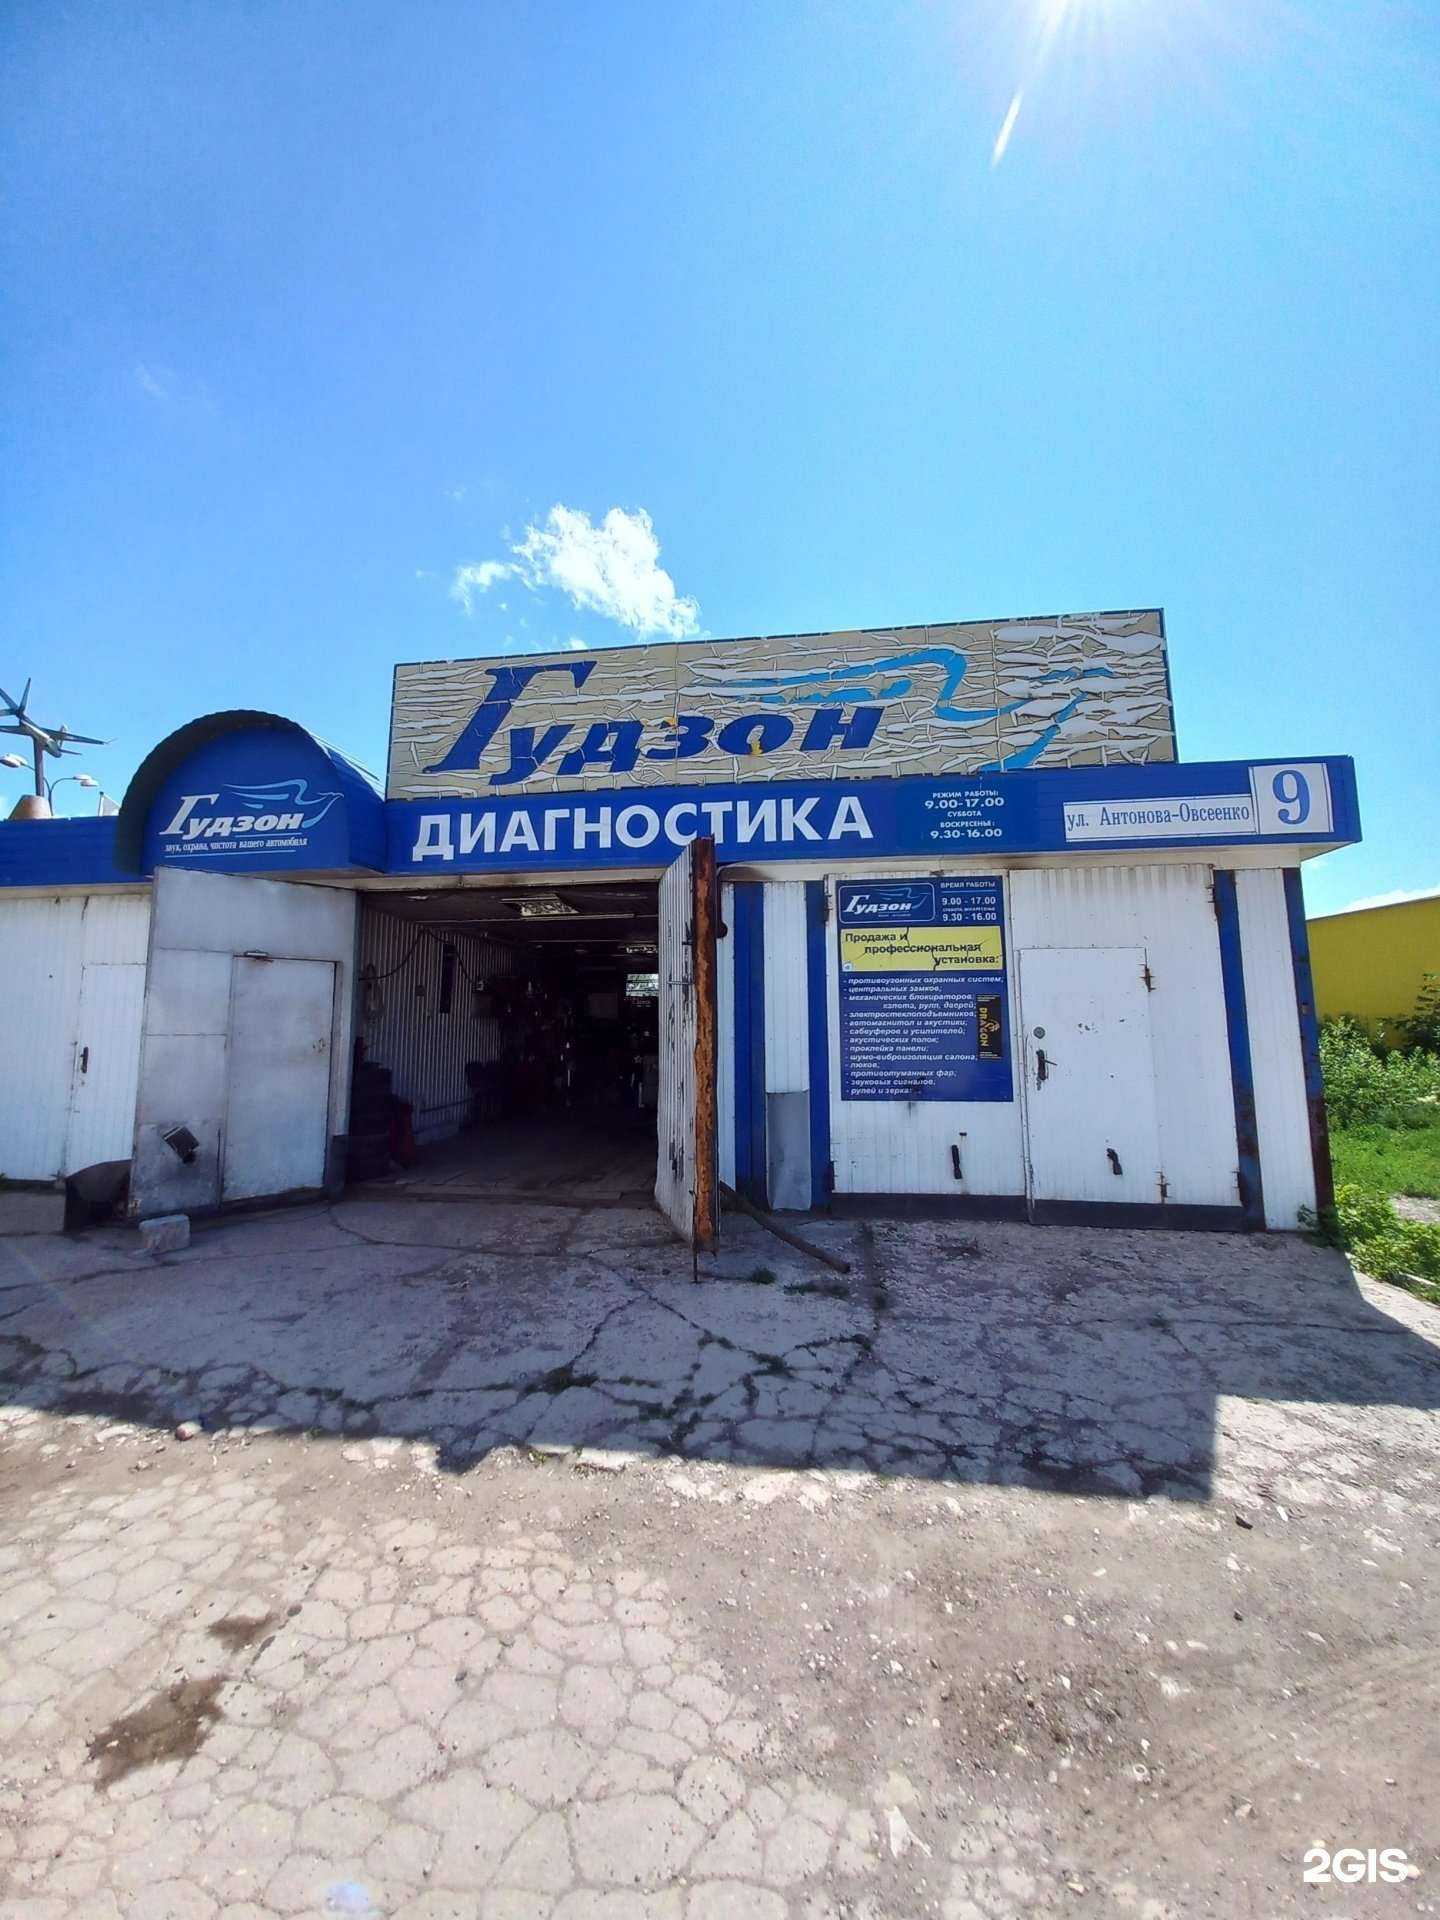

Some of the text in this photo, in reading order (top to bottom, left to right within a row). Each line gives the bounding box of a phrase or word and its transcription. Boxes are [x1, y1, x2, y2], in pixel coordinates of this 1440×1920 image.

[422, 660, 885, 786] Гудзон
[932, 791, 962, 799] РЕЖИМ
[1271, 769, 1311, 825] 9
[158, 793, 305, 840] Гудзон
[947, 810, 982, 818] СУББОТА
[1067, 803, 1250, 831] ул. Антонова-Овсеенко
[412, 796, 874, 862] ДИАГНОСТИКА
[843, 894, 912, 915] Гудзон
[971, 912, 997, 921] 16.00
[845, 932, 909, 944] Продажа и
[864, 943, 981, 955] профессиональная
[848, 977, 922, 986] противоугонных
[923, 976, 965, 985] охранных
[849, 1027, 901, 1036] сабвуферов
[979, 1007, 989, 1047] DRAGON
[850, 1070, 934, 1079] противотуманных
[850, 1087, 877, 1096] рулей
